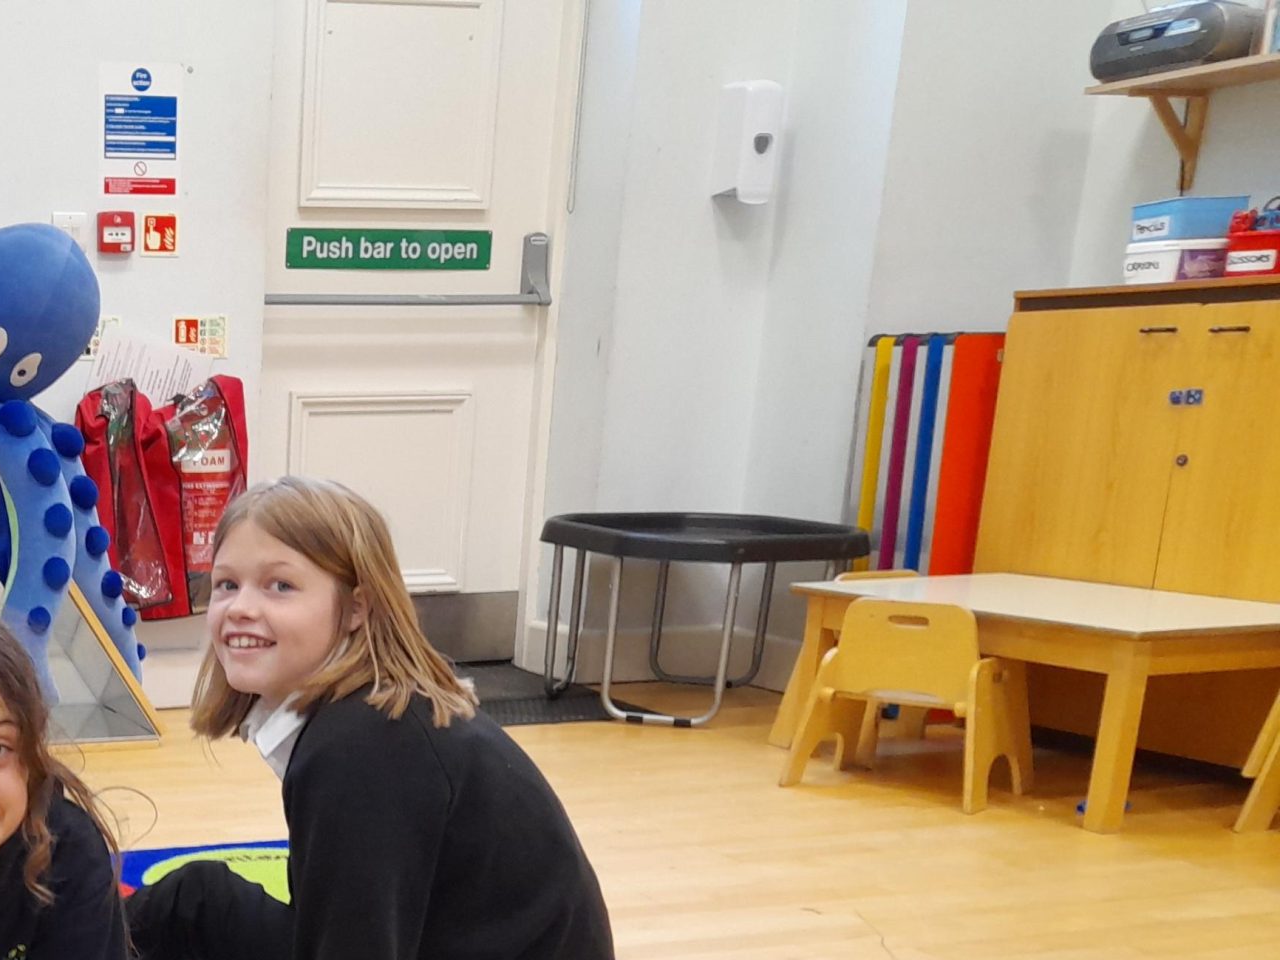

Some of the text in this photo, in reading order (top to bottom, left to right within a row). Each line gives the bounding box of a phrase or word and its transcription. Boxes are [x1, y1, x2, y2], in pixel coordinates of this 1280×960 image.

[302, 236, 478, 263] Push bar to open
